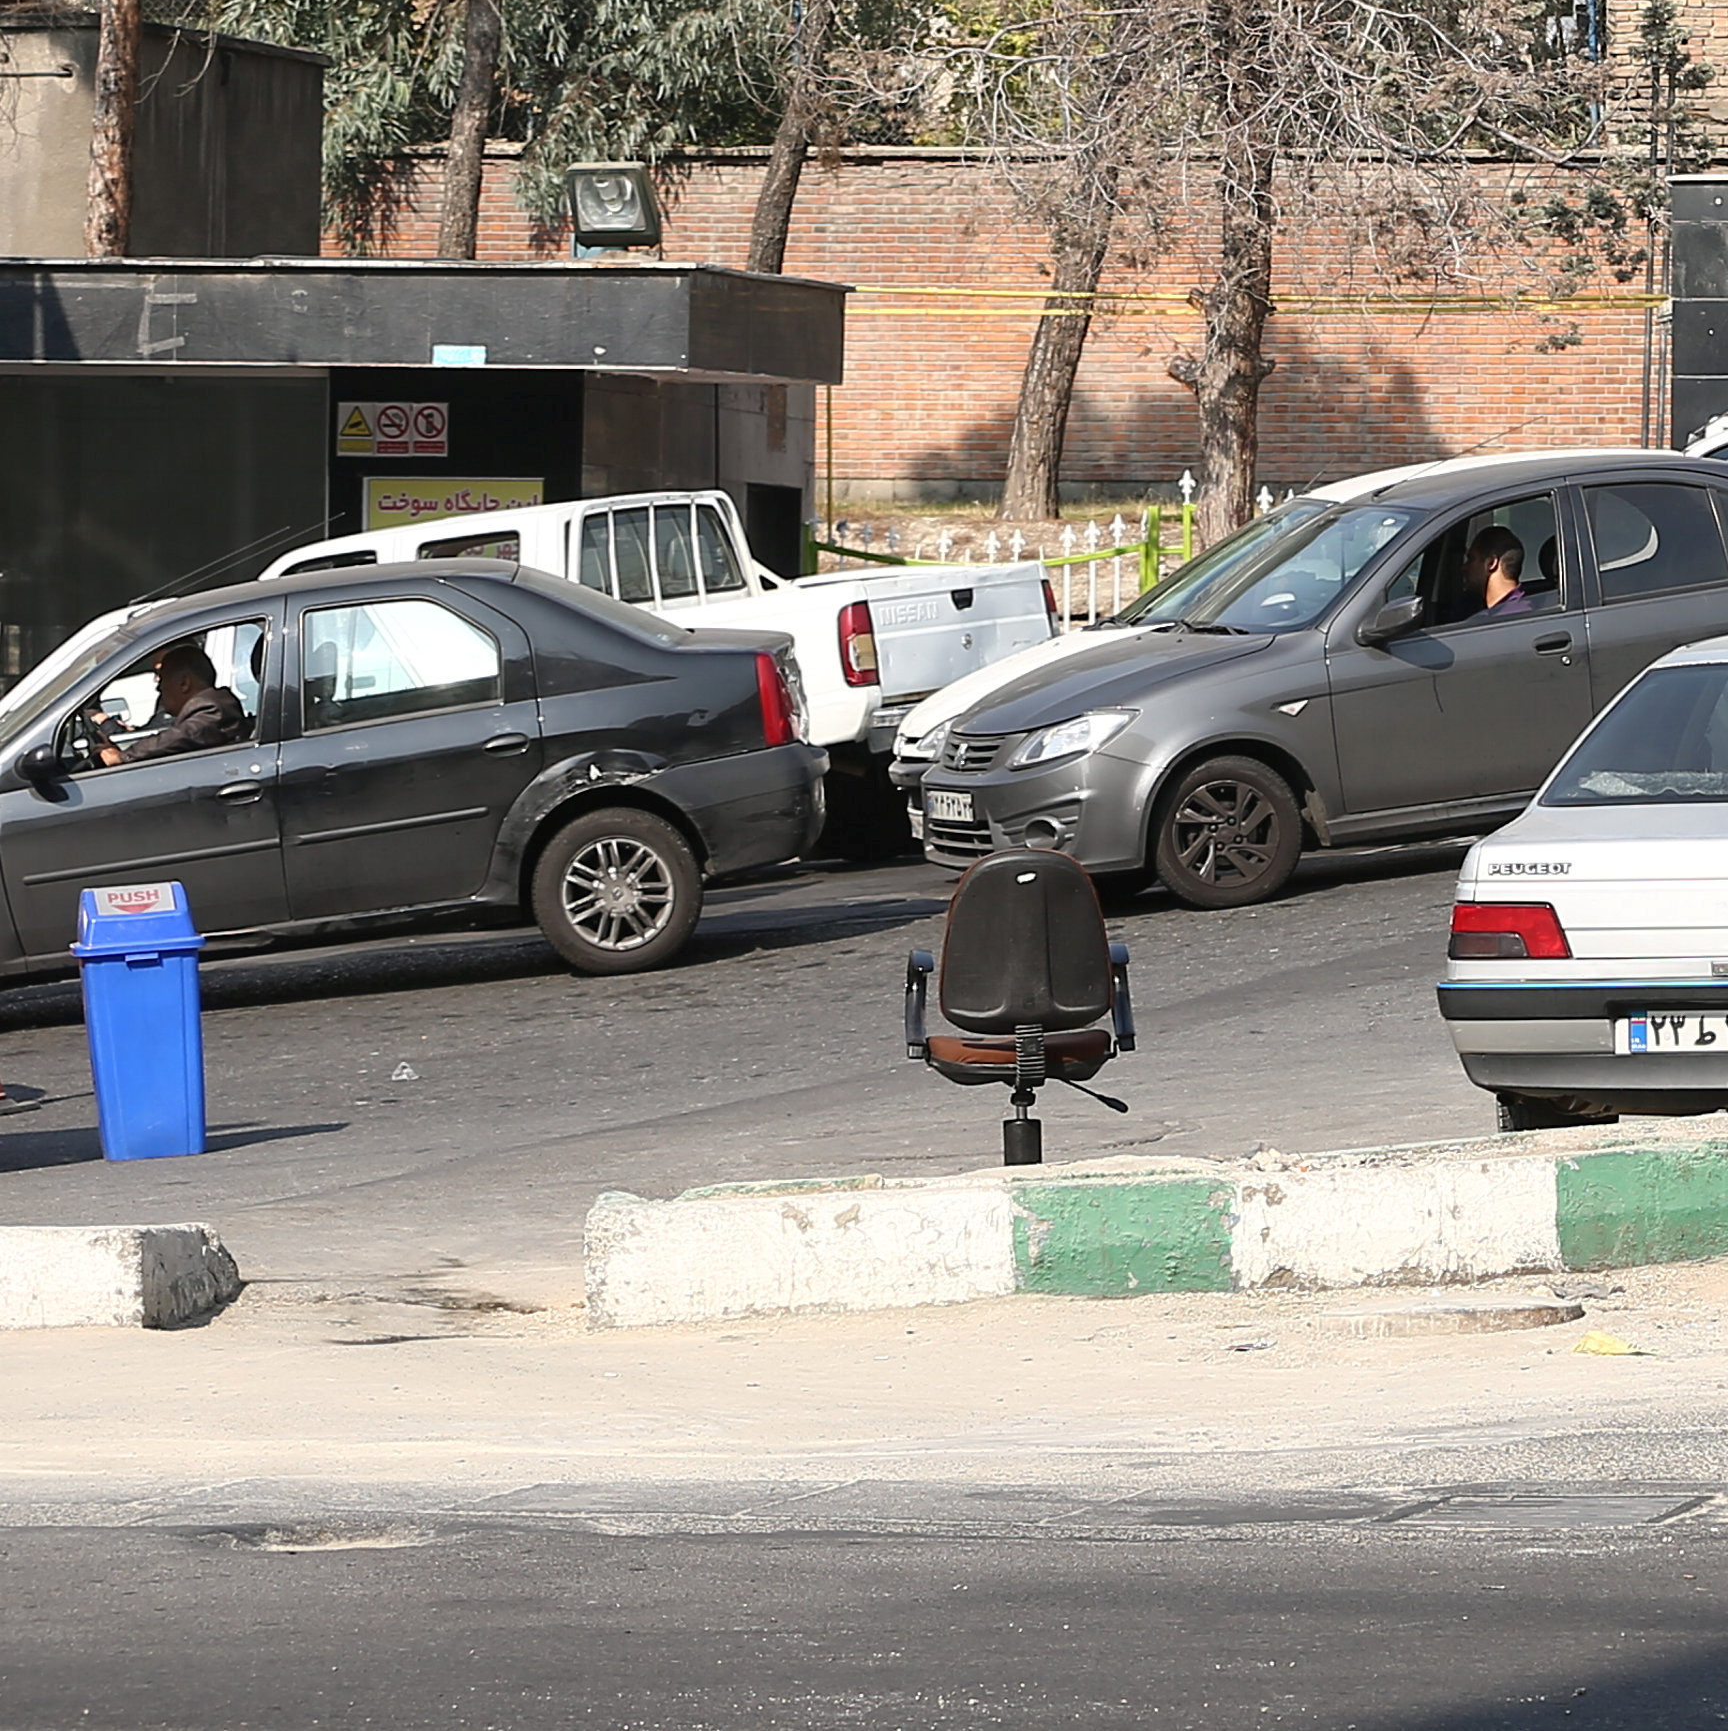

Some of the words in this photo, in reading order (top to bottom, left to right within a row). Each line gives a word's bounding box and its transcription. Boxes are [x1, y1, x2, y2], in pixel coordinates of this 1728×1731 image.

[378, 493, 438, 517] سوخت
[879, 601, 938, 626] NISSAN
[1488, 863, 1572, 876] PEUGEOT
[107, 889, 159, 903] PUSH
[1650, 1013, 1686, 1047] ۲۳
[1694, 1014, 1717, 1046] ط
